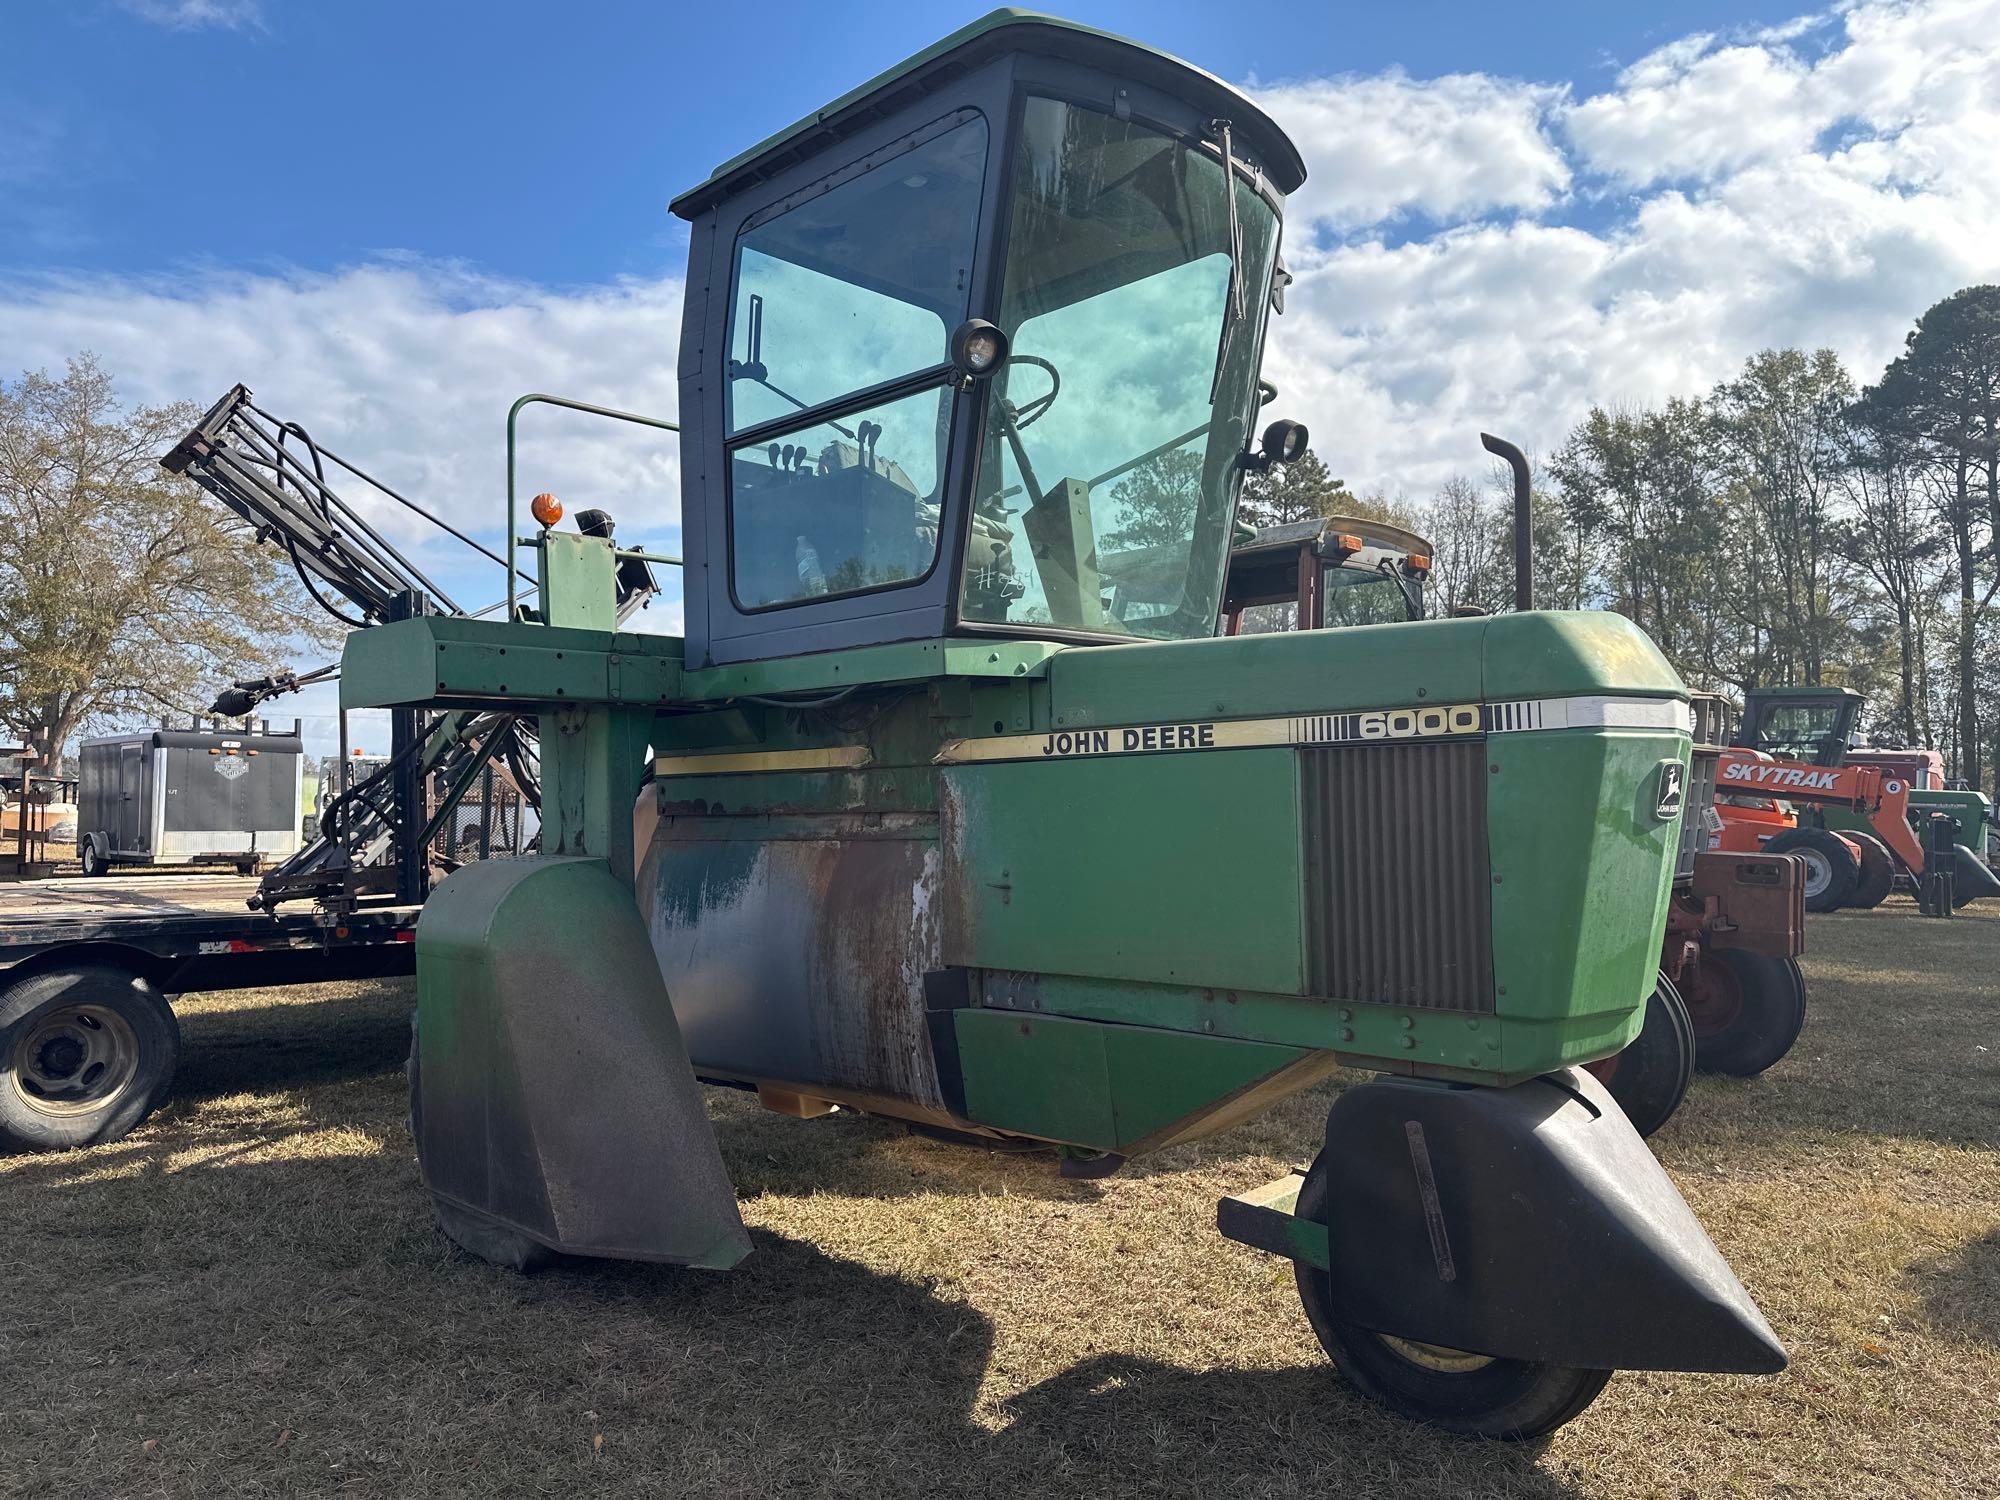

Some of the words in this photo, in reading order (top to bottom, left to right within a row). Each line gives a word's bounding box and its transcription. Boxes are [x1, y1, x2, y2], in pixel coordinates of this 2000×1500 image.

[1359, 705, 1480, 739] 6000
[1043, 733, 1109, 756] JOHN
[1122, 724, 1214, 751] DEERE
[1723, 763, 1840, 790] SKYTRAK
[1890, 783, 1897, 791] 6
[1658, 804, 1669, 813] JOHN
